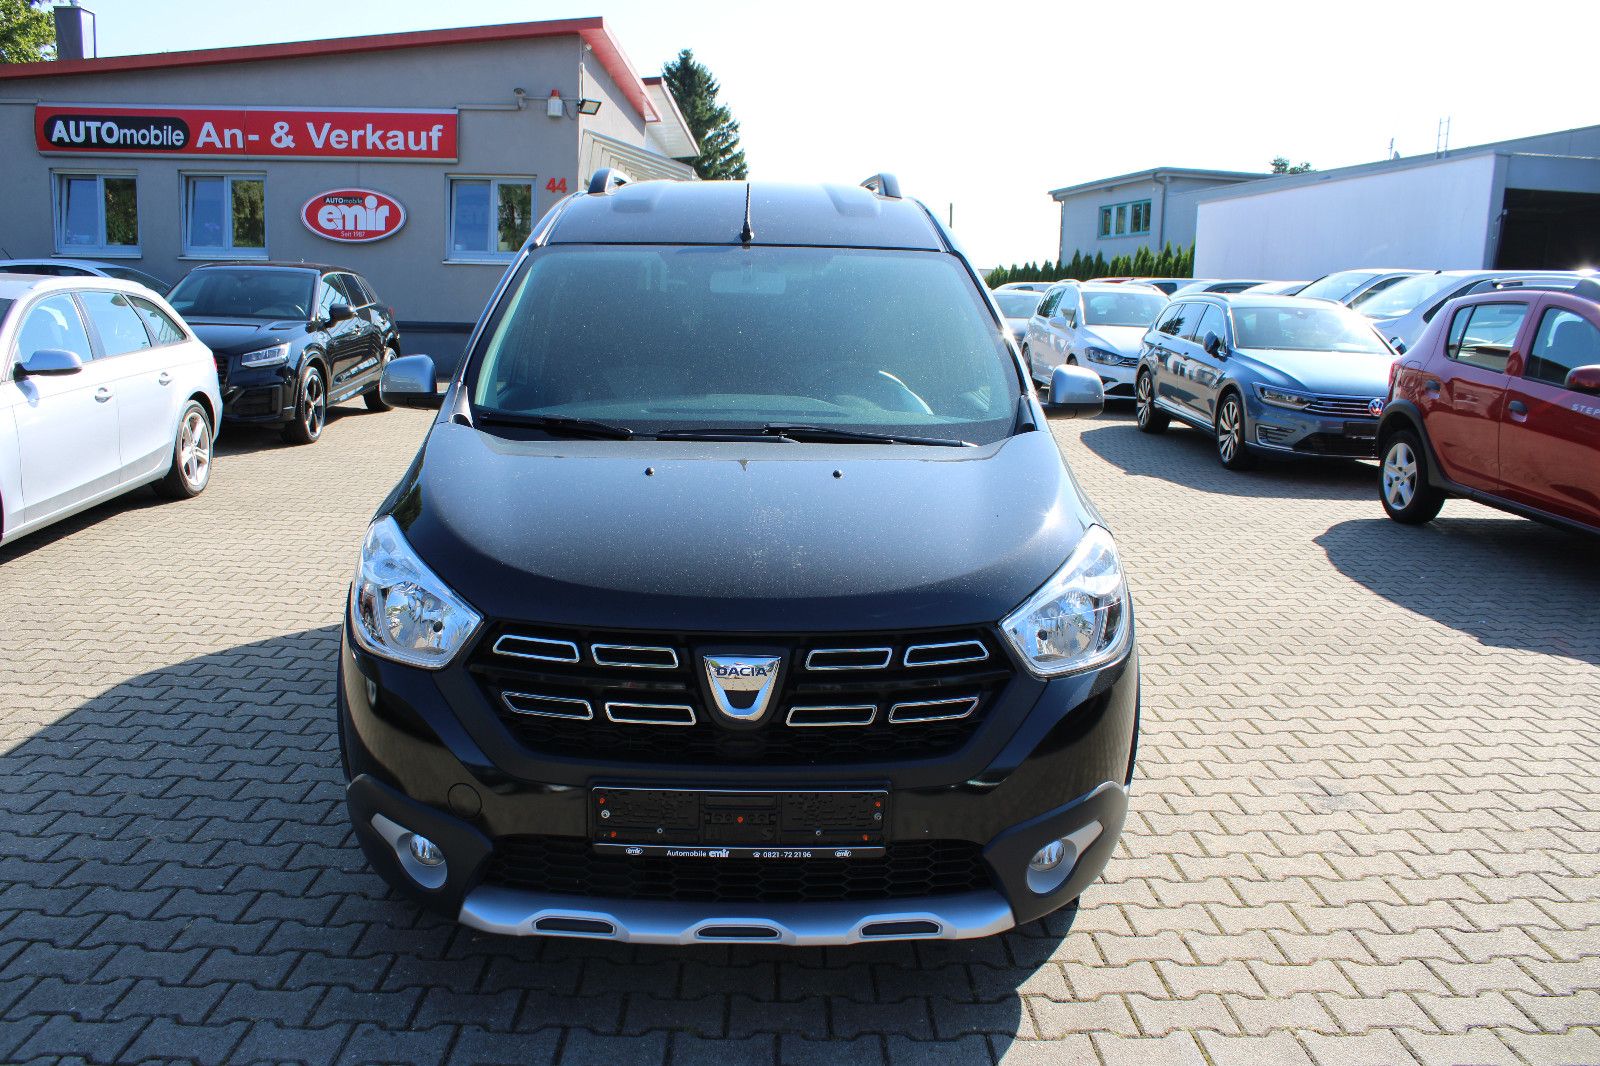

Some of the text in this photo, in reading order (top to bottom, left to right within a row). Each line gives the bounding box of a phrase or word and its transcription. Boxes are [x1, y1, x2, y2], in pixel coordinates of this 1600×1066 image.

[51, 120, 444, 152] AUTOmobile An- & Verkauf
[545, 177, 567, 193] 44
[318, 195, 389, 230] emir
[716, 667, 768, 677] DACIA
[666, 848, 730, 858] Automobile emir
